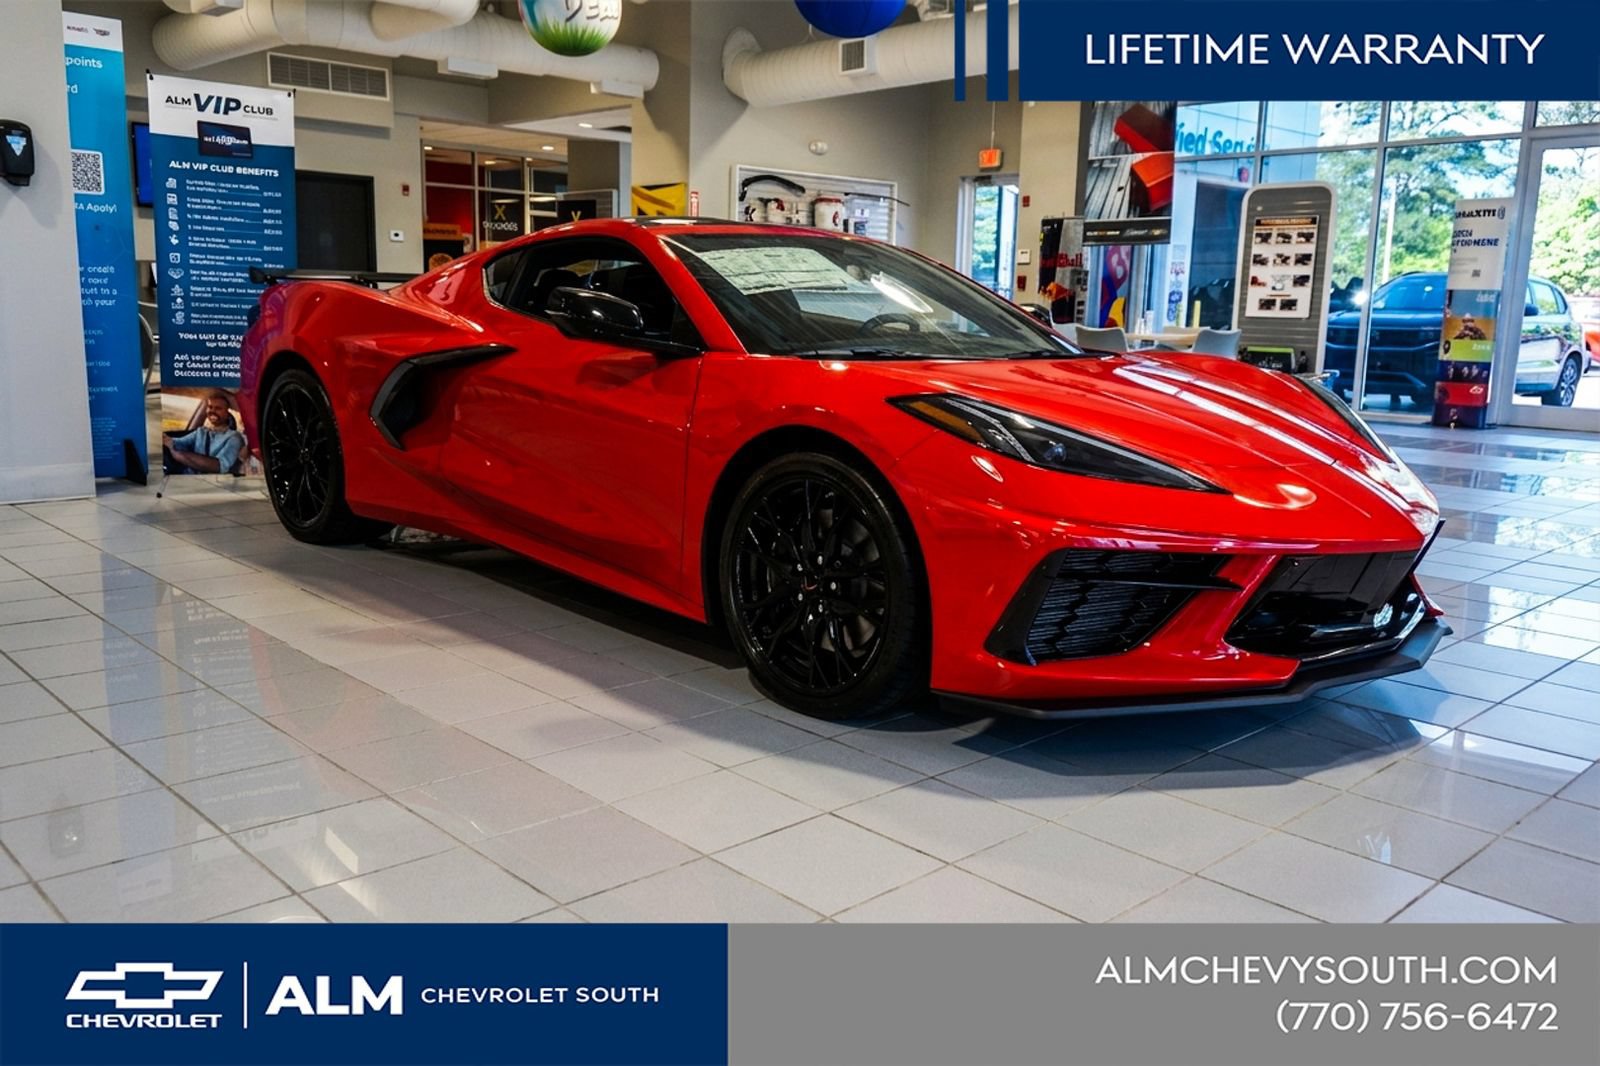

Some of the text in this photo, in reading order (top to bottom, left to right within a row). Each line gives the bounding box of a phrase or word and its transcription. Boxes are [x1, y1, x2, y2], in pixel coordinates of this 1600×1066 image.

[65, 56, 103, 69] points
[165, 93, 274, 116] ALM VIP CLUB
[192, 162, 209, 171] VIP
[236, 166, 280, 178] BENEFITS
